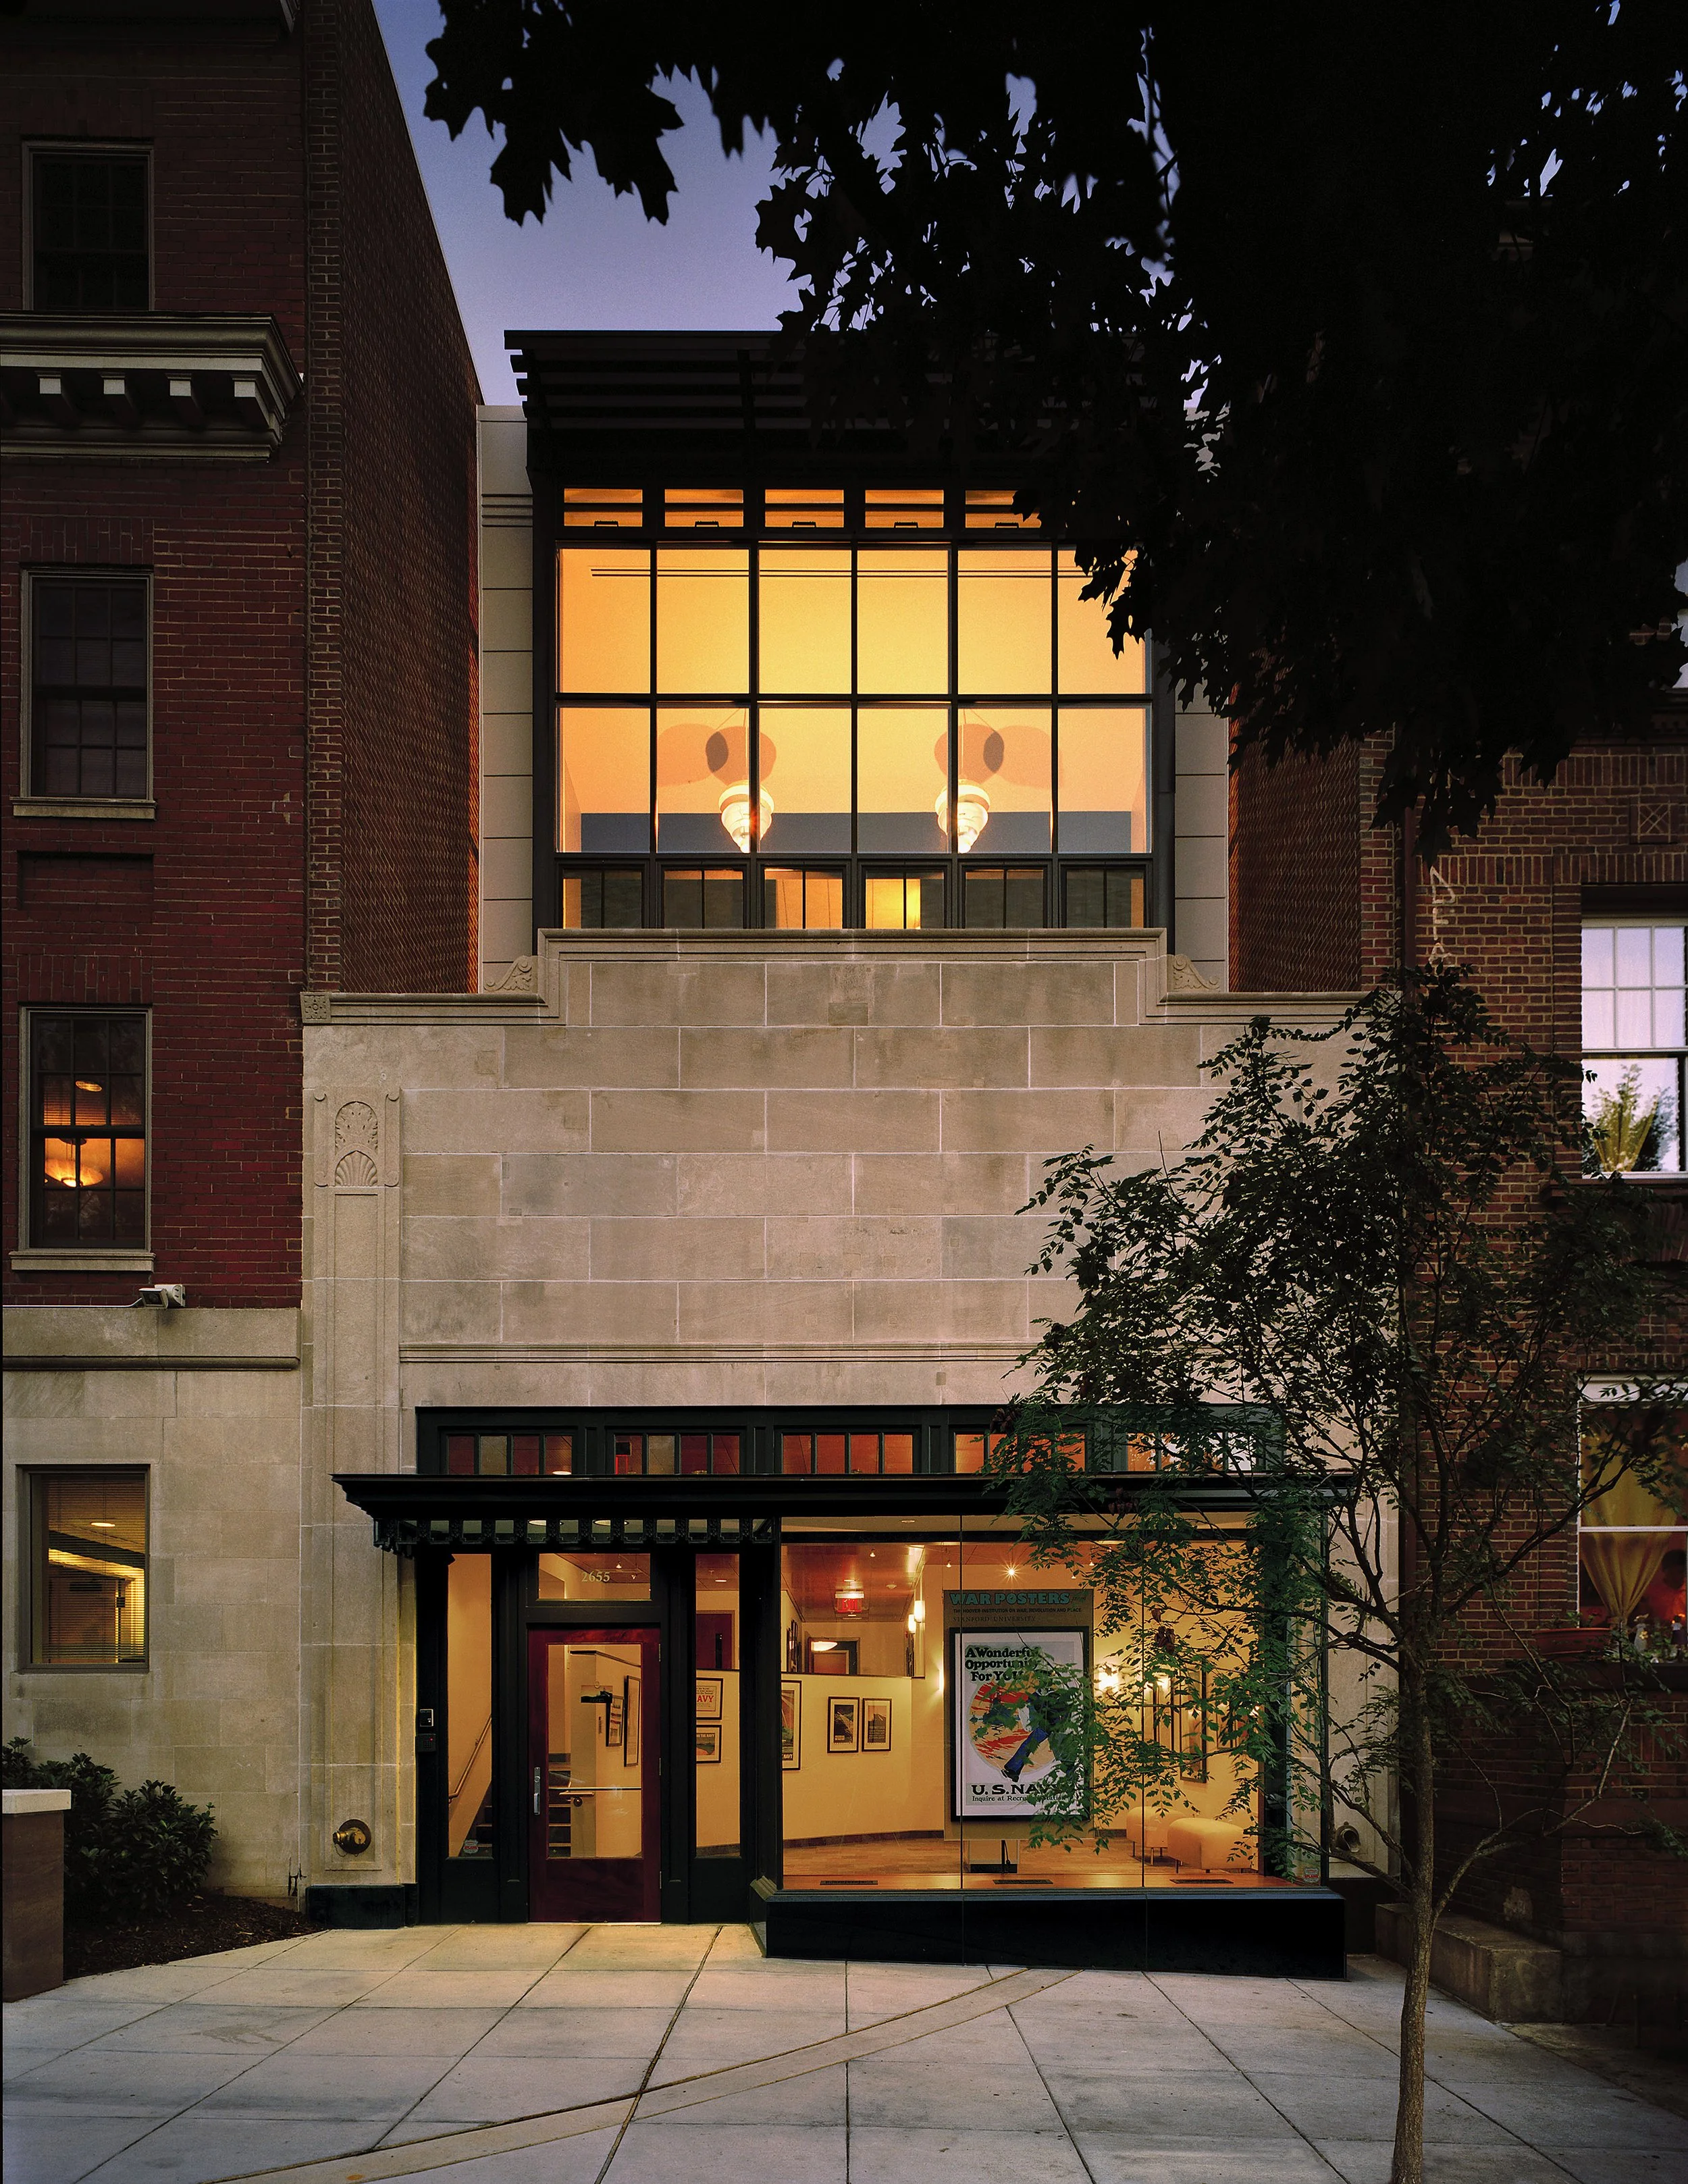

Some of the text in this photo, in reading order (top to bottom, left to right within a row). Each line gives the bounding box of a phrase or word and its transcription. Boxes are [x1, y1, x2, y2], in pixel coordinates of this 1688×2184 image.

[581, 1570, 610, 1582] 2655
[949, 1592, 992, 1605] WAR
[994, 1592, 1070, 1605] POSTERS
[965, 1648, 976, 1658] A
[970, 1671, 993, 1681] For
[971, 1784, 988, 1796] U.
[992, 1784, 1009, 1795] S.
